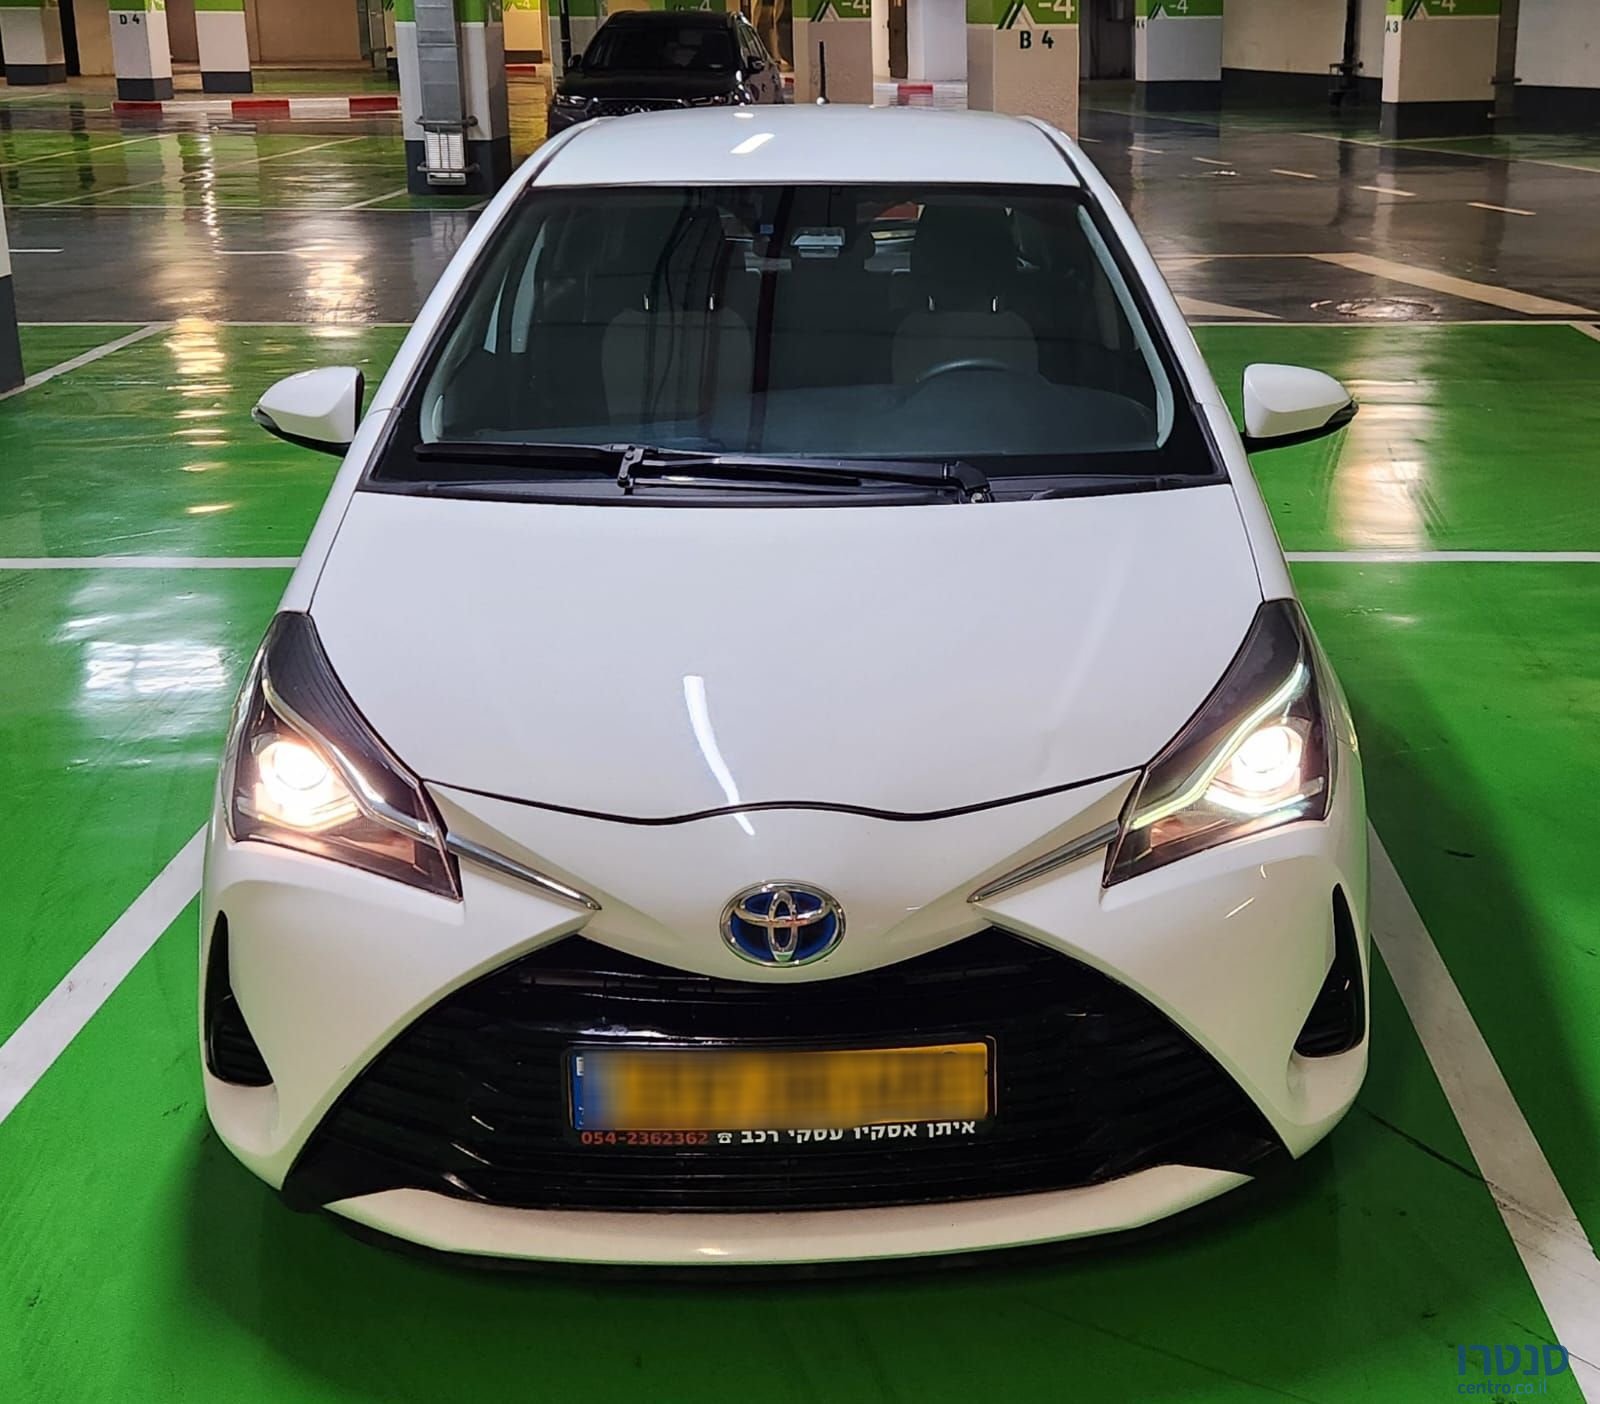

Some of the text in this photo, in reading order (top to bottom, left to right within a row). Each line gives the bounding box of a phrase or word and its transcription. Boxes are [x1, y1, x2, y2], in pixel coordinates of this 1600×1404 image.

[1038, 0, 1075, 19] -4
[1168, 0, 1188, 13] -4
[120, 14, 140, 24] D 4
[1385, 21, 1399, 32] A 3
[1020, 30, 1055, 49] B 4
[581, 1121, 976, 1145] איתן אסקיו עסקי רכב 054-2362362
